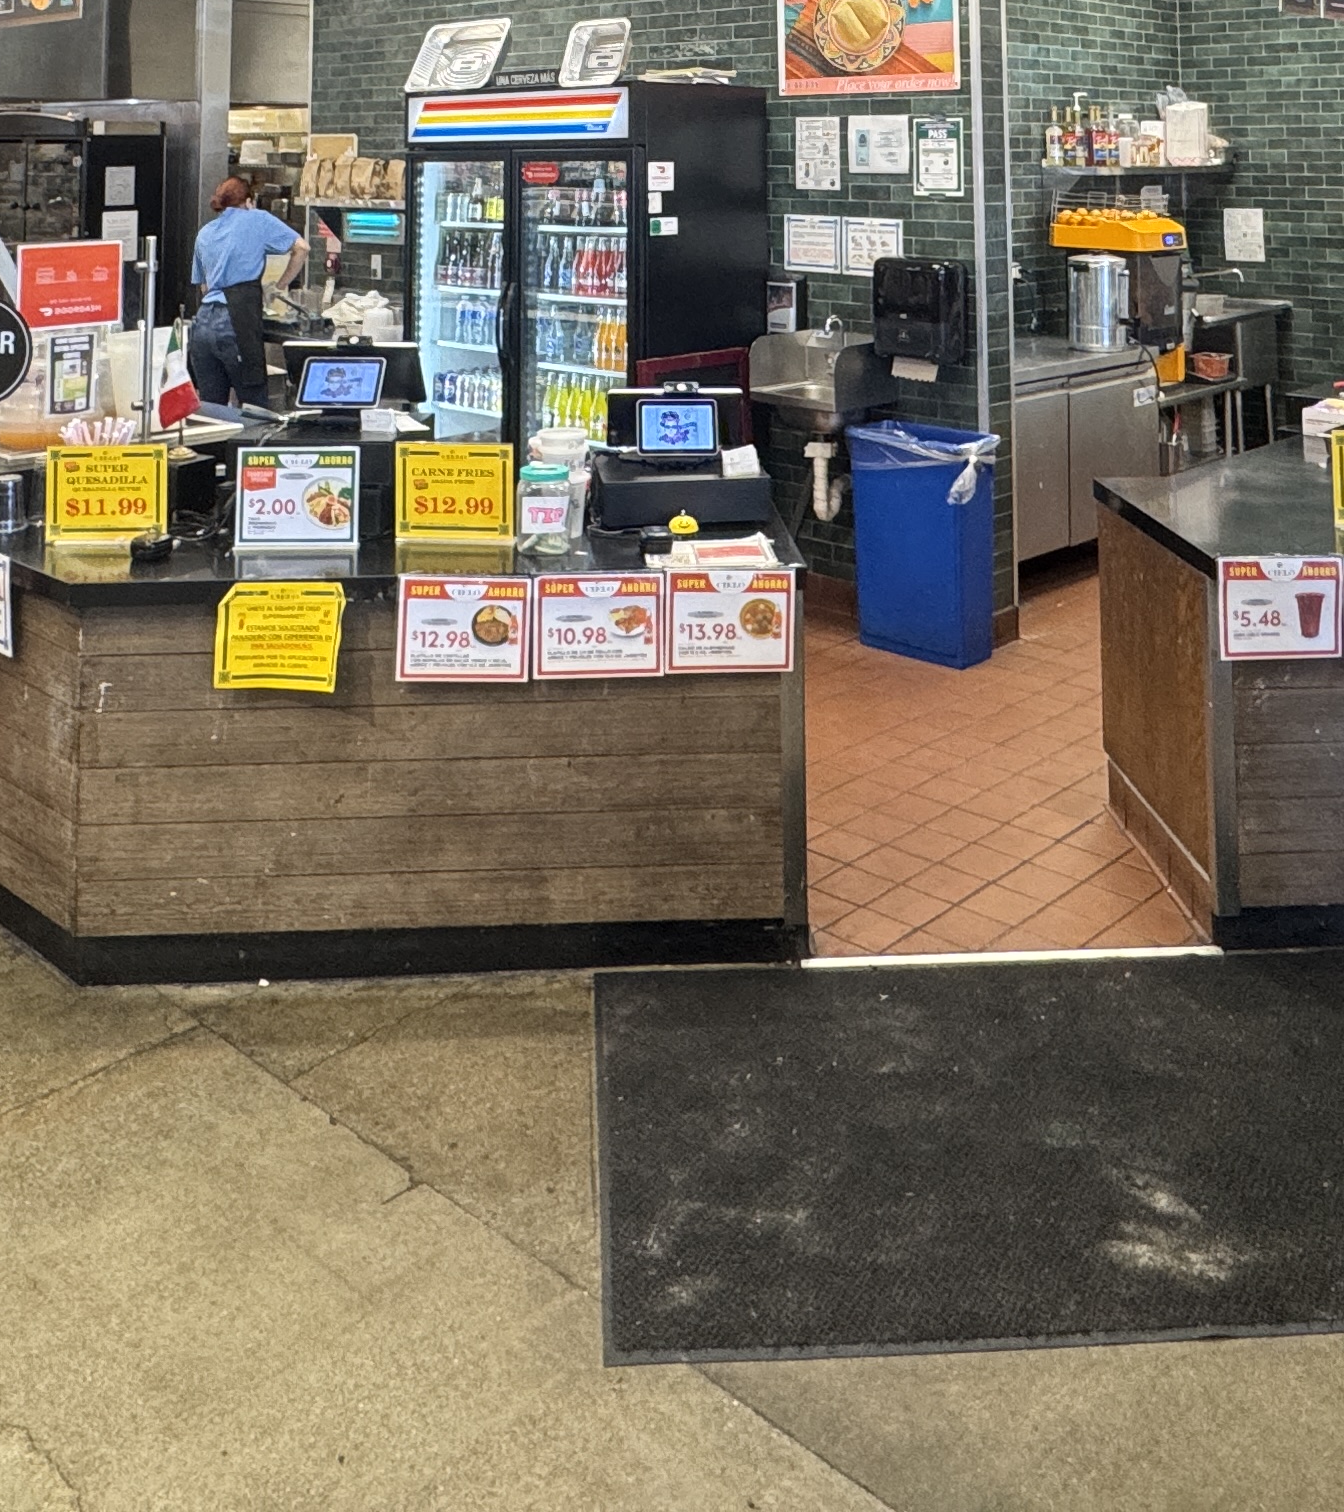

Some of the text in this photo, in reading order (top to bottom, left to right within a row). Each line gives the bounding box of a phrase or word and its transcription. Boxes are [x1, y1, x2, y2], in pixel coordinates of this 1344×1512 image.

[496, 69, 556, 86] UNA CERVEZA MÁS
[835, 76, 956, 92] Place your order now!
[928, 129, 948, 139] PASS
[247, 455, 353, 465] SUPER AHORRO
[85, 464, 130, 473] SUPER
[411, 467, 495, 478] CARNE FRIES
[66, 475, 148, 485] QUESADILLA
[65, 497, 147, 517] $11.99
[248, 498, 296, 515] $2.00
[414, 495, 494, 516] $12.99
[1229, 566, 1258, 577] SUPER
[1302, 566, 1337, 577] AHORRO
[544, 582, 575, 594] SUPER
[621, 582, 657, 593] AHORRO
[676, 578, 706, 589] SUPER
[751, 579, 788, 589] AHORRO
[410, 585, 441, 596] SUPER
[487, 586, 525, 598] AHORRO
[1232, 610, 1281, 627] $5.48
[547, 627, 607, 645] $10.98
[679, 622, 737, 641] $13.98
[412, 630, 470, 649] $12.98
